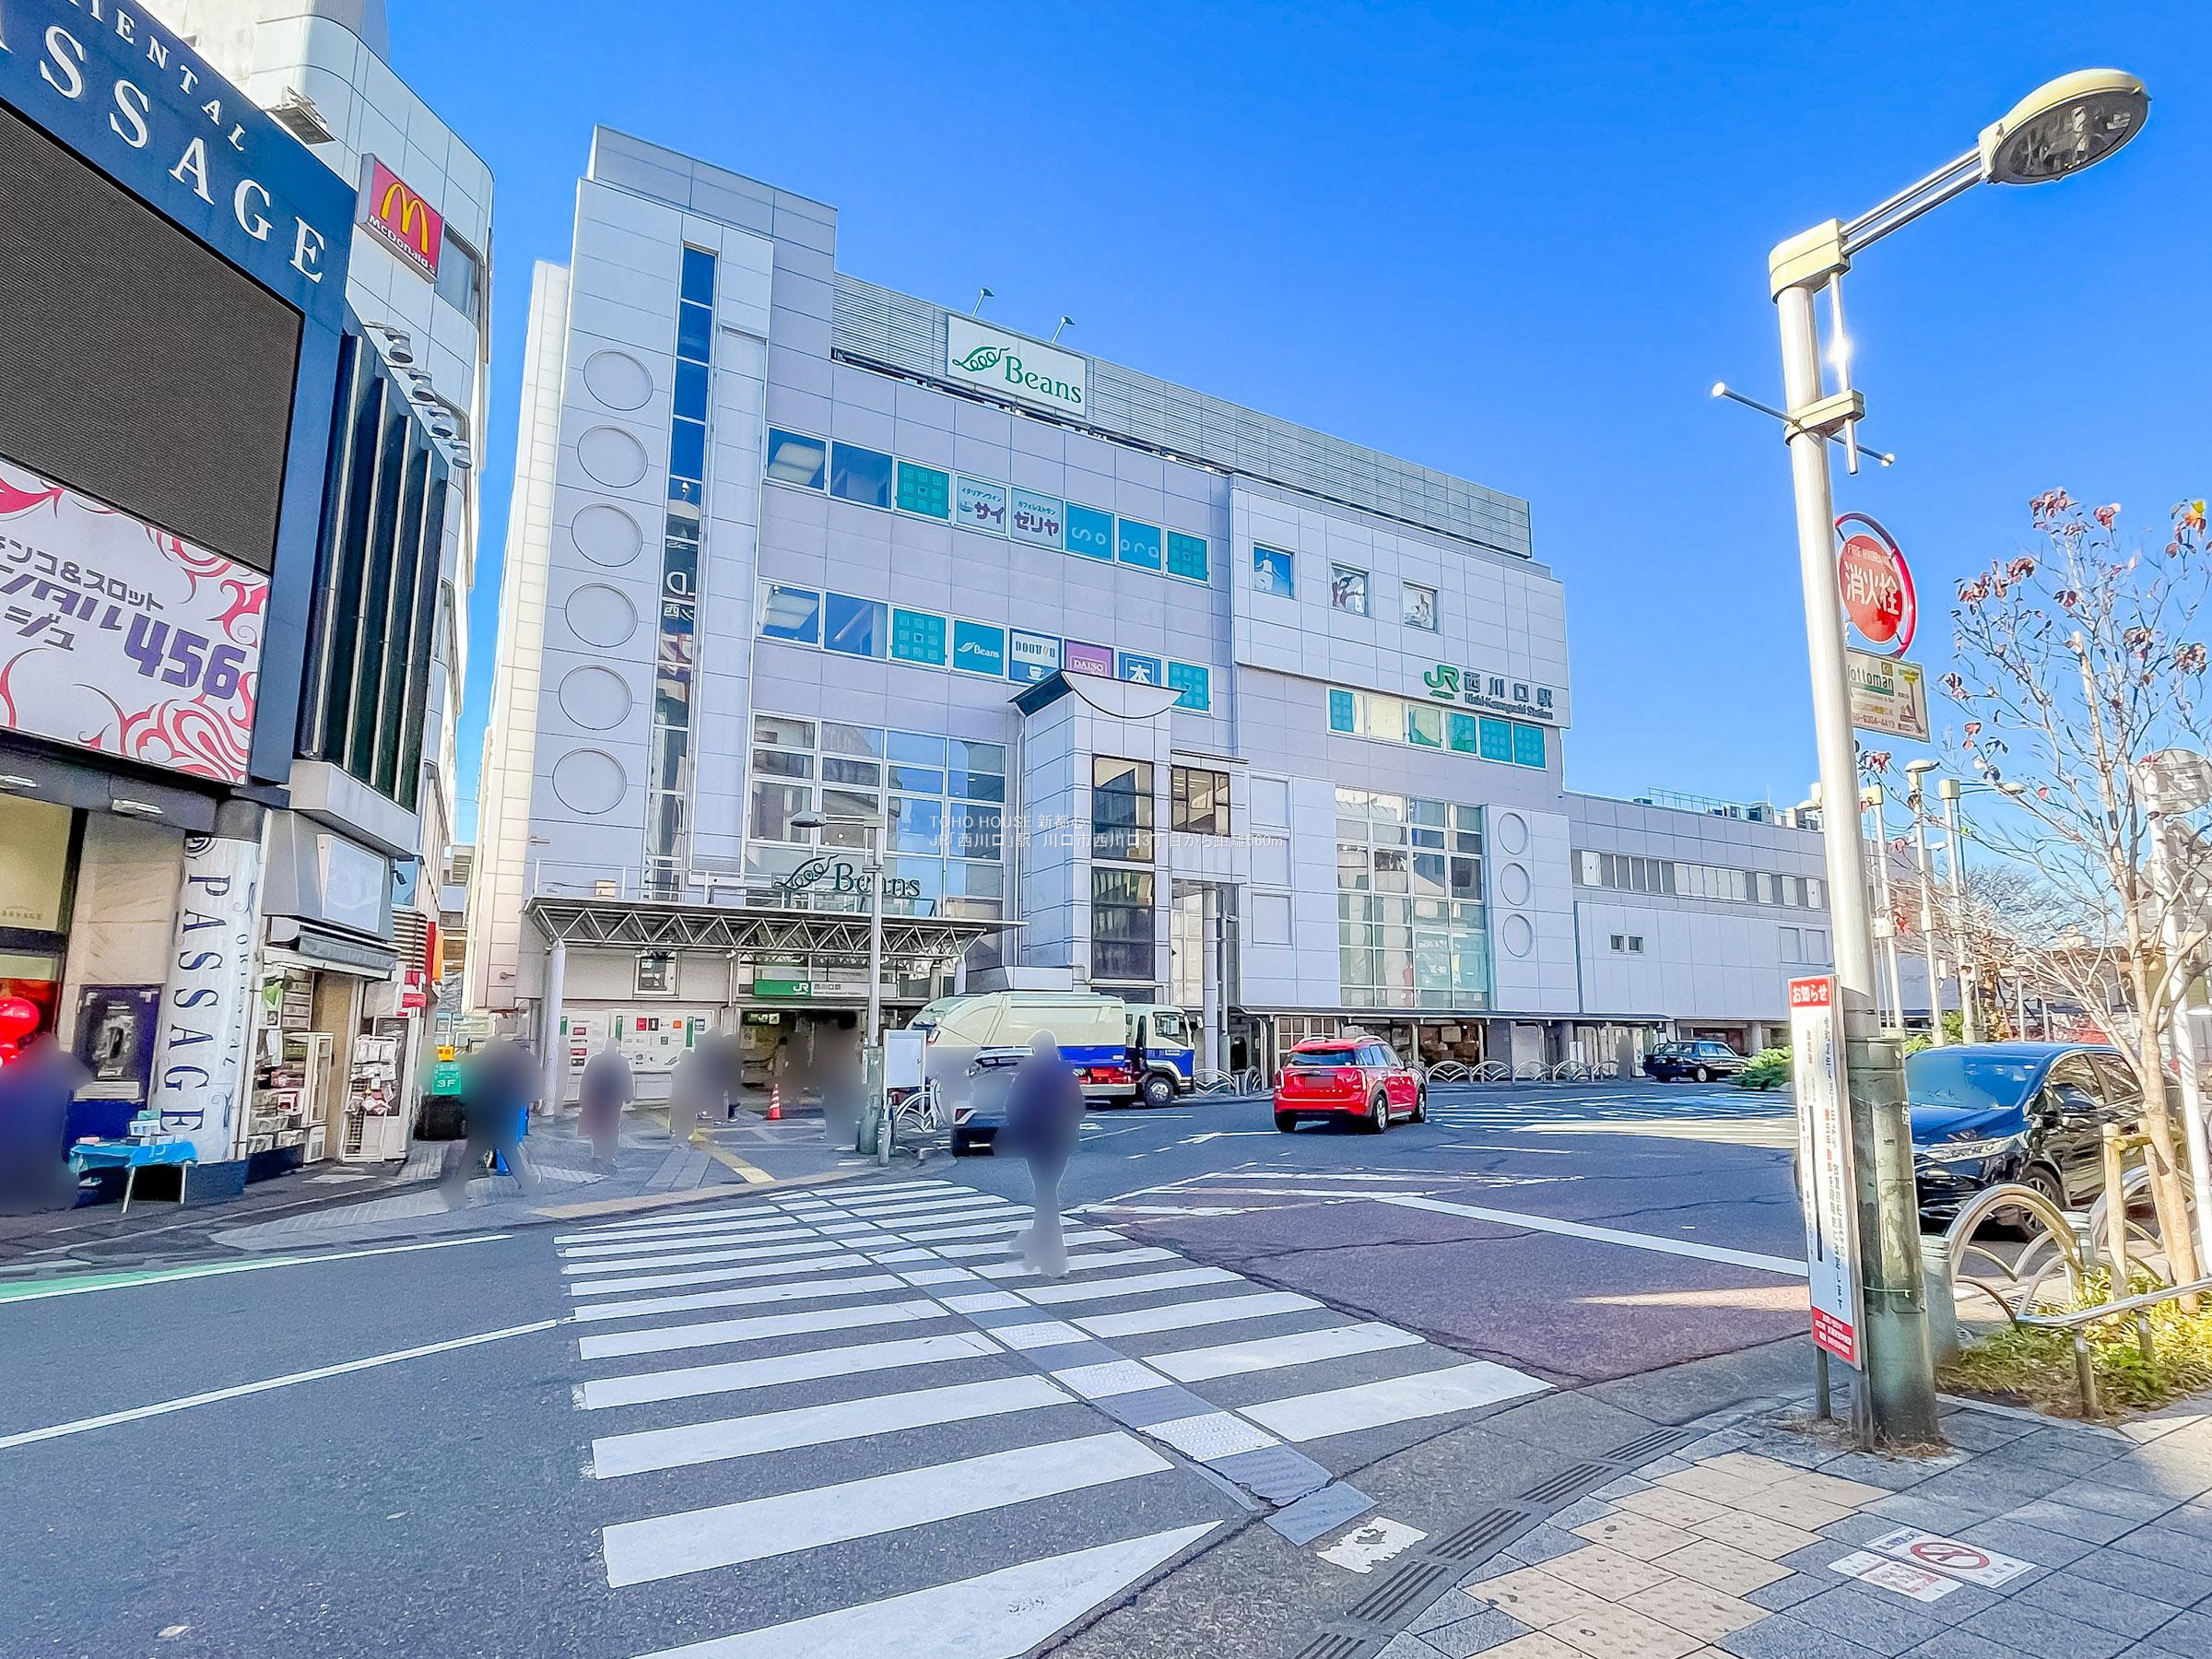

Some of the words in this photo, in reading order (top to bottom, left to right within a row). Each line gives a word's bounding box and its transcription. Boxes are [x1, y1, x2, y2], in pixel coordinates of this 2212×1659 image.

[68, 0, 245, 152] IENTAL
[0, 25, 325, 284] SSAGE
[1005, 356, 1082, 404] Beans
[0, 535, 165, 612] ンコ&スロット
[1844, 560, 1900, 616] 消火栓
[973, 643, 1000, 659] Beans
[1074, 659, 1104, 672] DAISO
[1424, 665, 1460, 692] JR
[1464, 671, 1554, 708] 西川口駅
[160, 874, 230, 1132] PASSAGE
[793, 982, 809, 993] JR
[1792, 983, 1829, 1004] お知らせ
[436, 1078, 456, 1088] 3F
